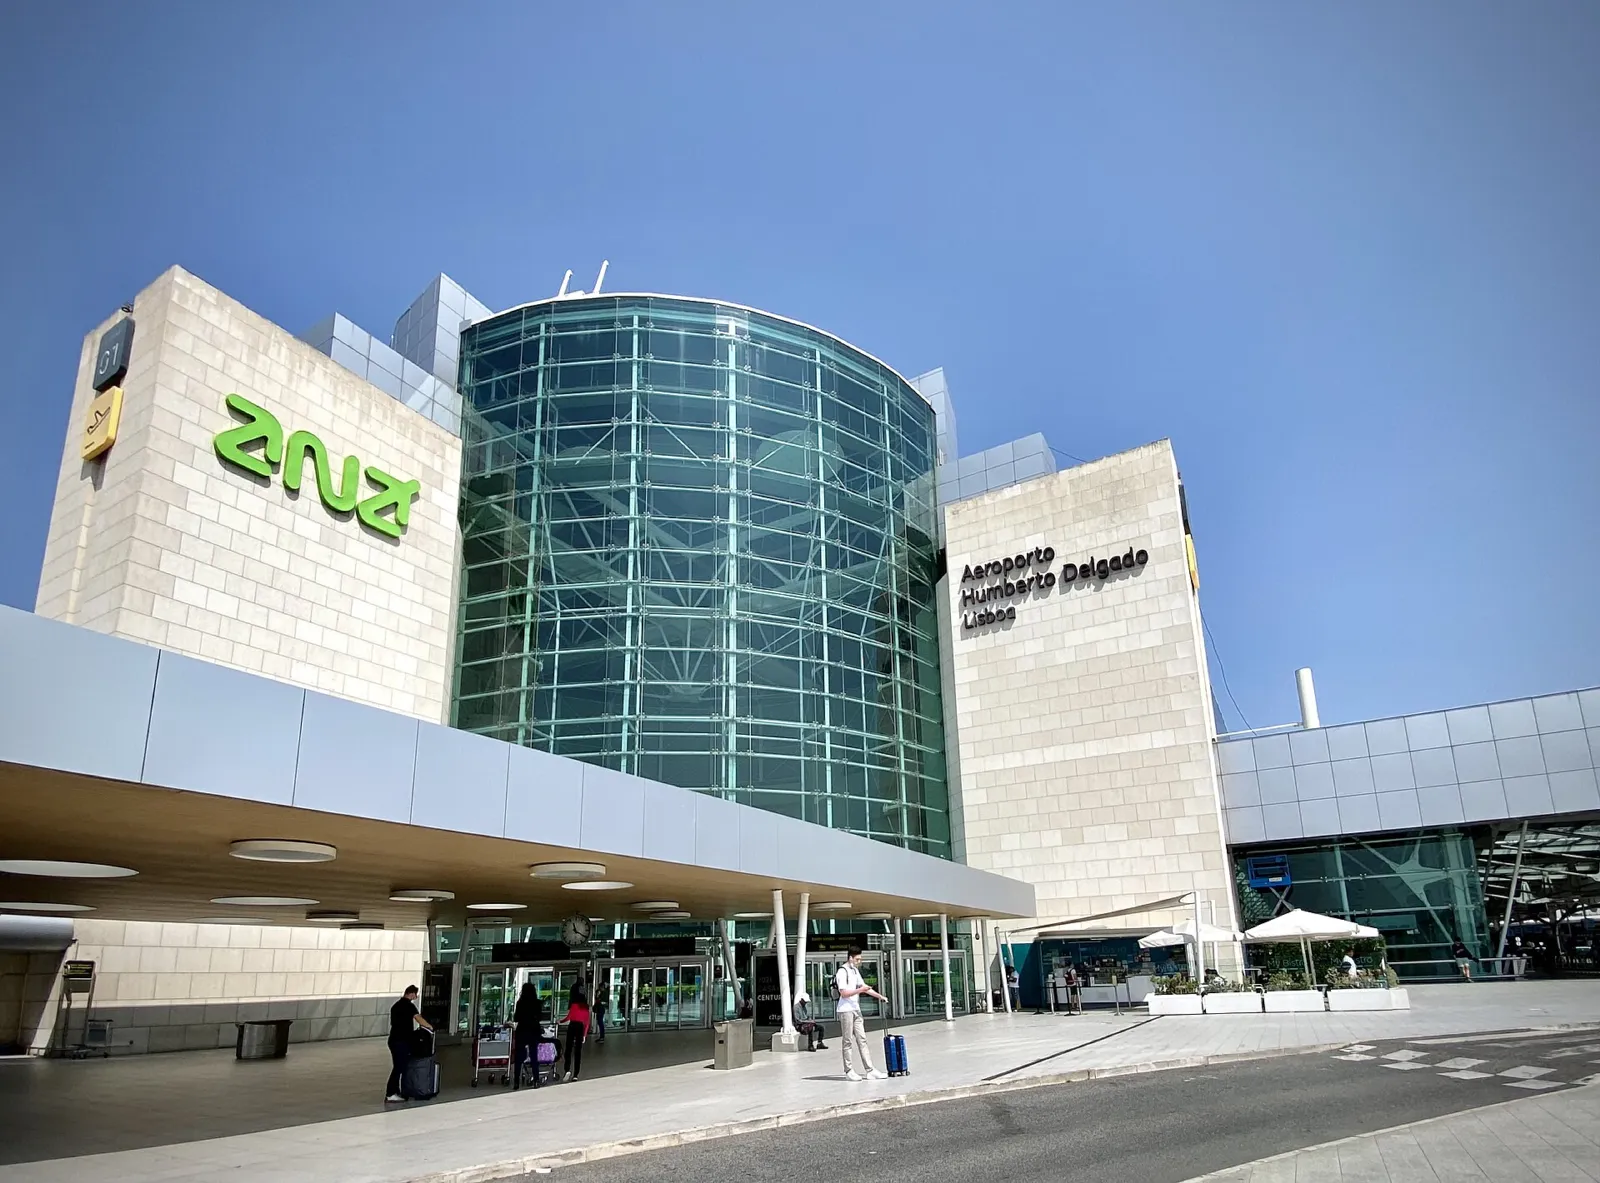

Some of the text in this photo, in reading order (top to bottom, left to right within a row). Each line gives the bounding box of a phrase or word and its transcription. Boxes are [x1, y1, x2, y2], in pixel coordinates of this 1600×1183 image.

[99, 343, 119, 375] 01
[961, 546, 1055, 583] Aeroporto
[962, 546, 1149, 607] Humberto Delgado
[963, 606, 1016, 629] Lisboa
[1283, 958, 1304, 966] Bistr
